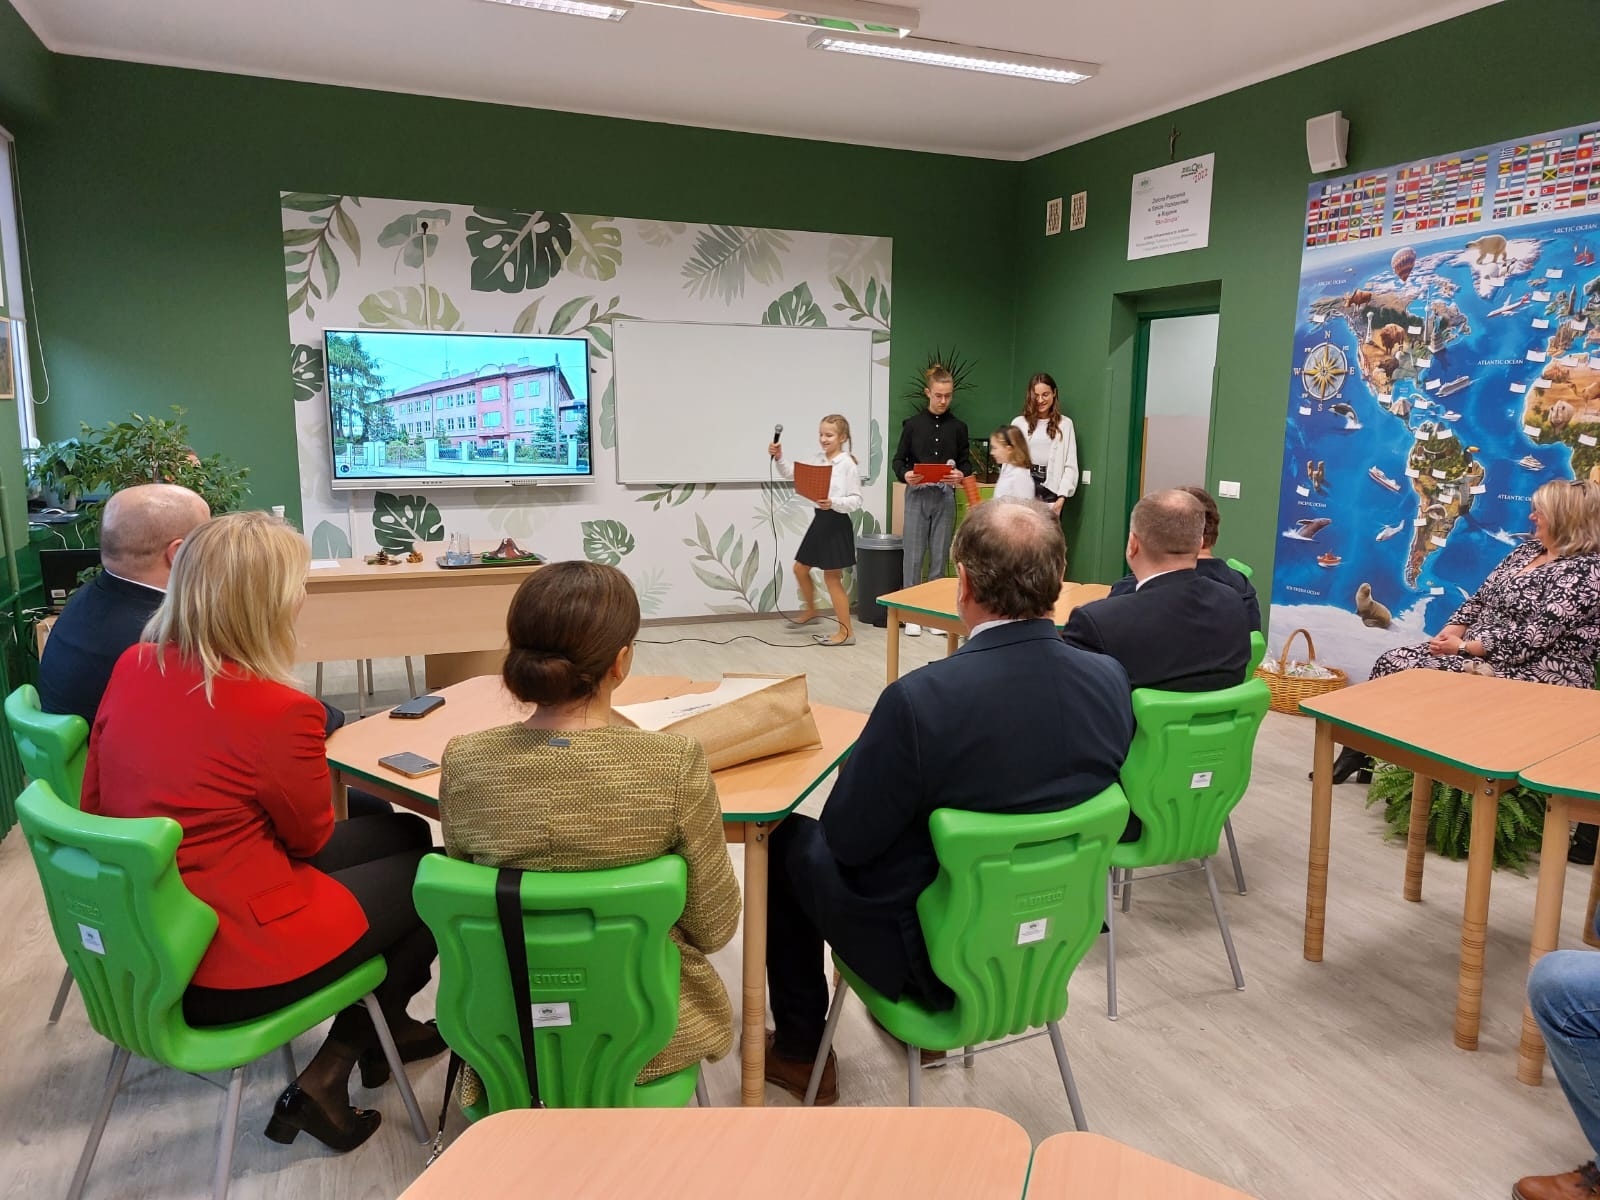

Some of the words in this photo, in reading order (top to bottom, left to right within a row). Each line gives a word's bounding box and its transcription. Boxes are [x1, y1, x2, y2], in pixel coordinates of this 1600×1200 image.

[1324, 330, 1332, 339] N
[1293, 367, 1301, 376] W
[1349, 366, 1355, 375] E
[1317, 403, 1323, 412] S
